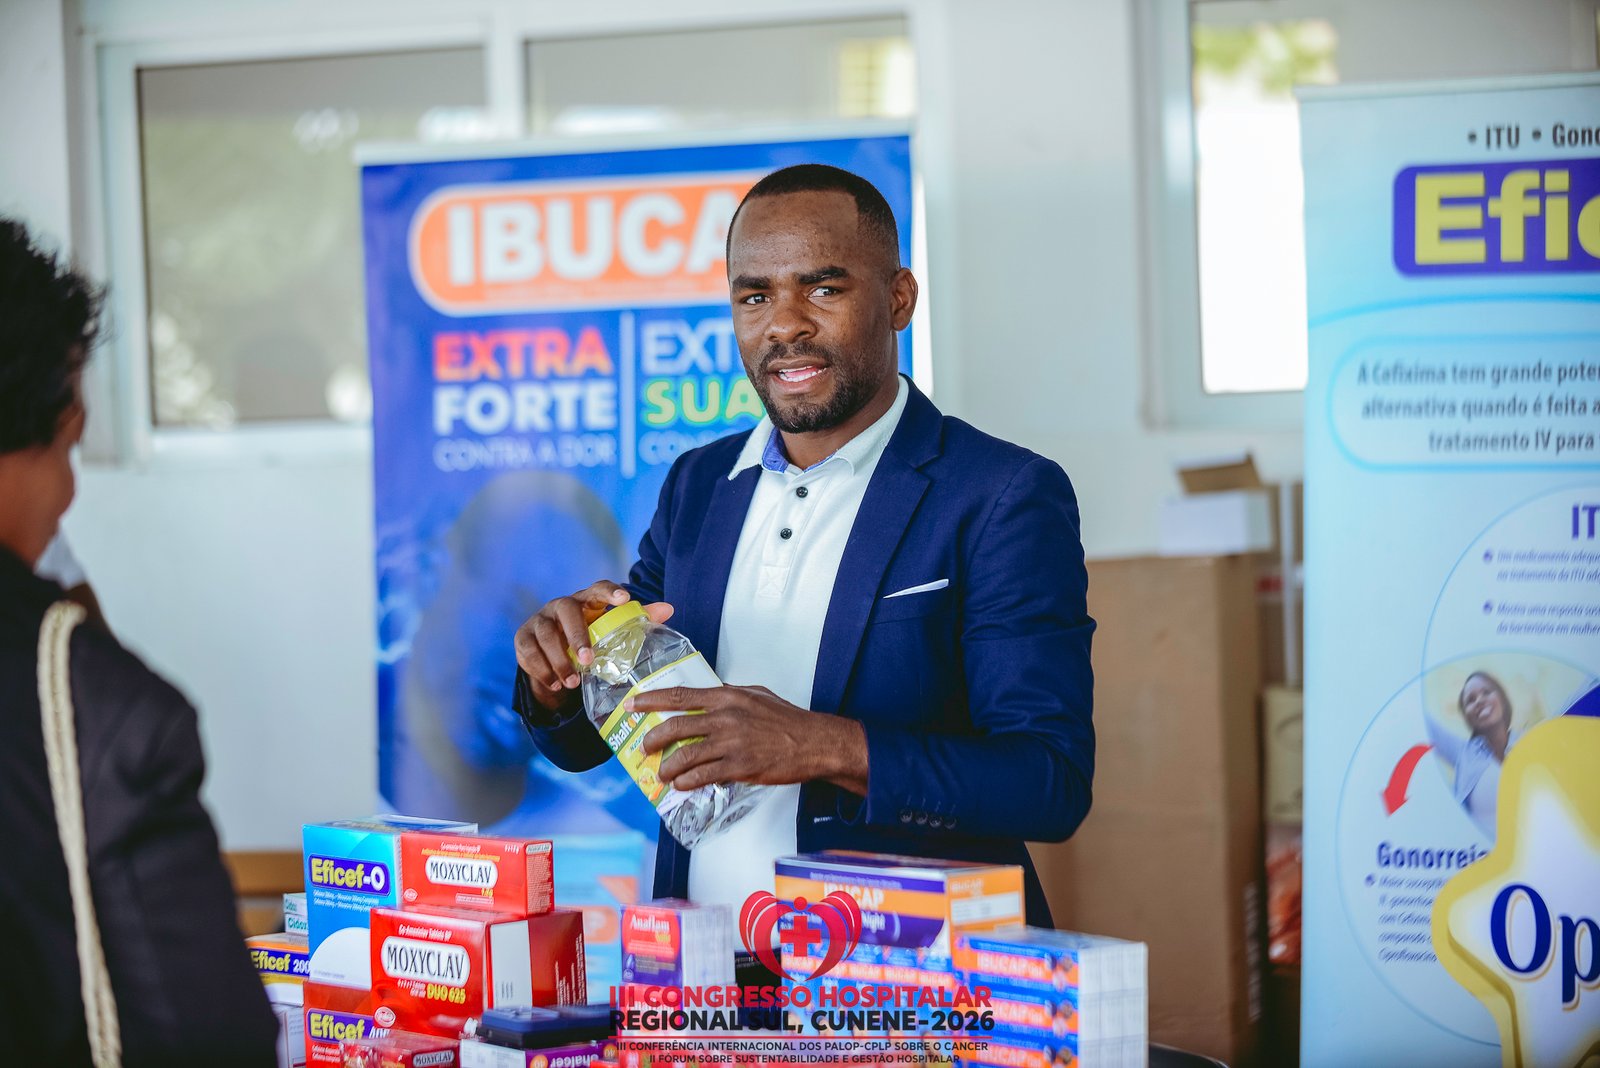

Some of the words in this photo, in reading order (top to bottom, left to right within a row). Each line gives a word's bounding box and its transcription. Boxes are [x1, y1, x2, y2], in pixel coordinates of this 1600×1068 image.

[1486, 125, 1520, 150] ITU
[434, 329, 612, 381] EXTRA
[643, 319, 745, 375] EXT
[1452, 361, 1486, 384] tem
[1491, 359, 1552, 388] grande
[1557, 361, 1600, 387] pote
[434, 382, 616, 434] FORTE
[1361, 395, 1456, 419] alternativa
[1462, 394, 1528, 421] quando
[1532, 394, 1543, 417] é
[1547, 394, 1588, 417] feita
[1428, 429, 1530, 453] tratamento
[1534, 428, 1551, 450] IV
[1555, 434, 1595, 456] para
[311, 858, 386, 891] Eficef-O
[430, 861, 492, 884] MOXYCLAV
[630, 913, 670, 932] Anaflam
[1490, 884, 1600, 1005] Op
[386, 943, 465, 980] MOXYCLAV
[427, 983, 448, 1001] DUO
[448, 986, 467, 1004] 625
[310, 1013, 365, 1040] Eficef
[415, 1050, 453, 1066] MOXYCLAV
